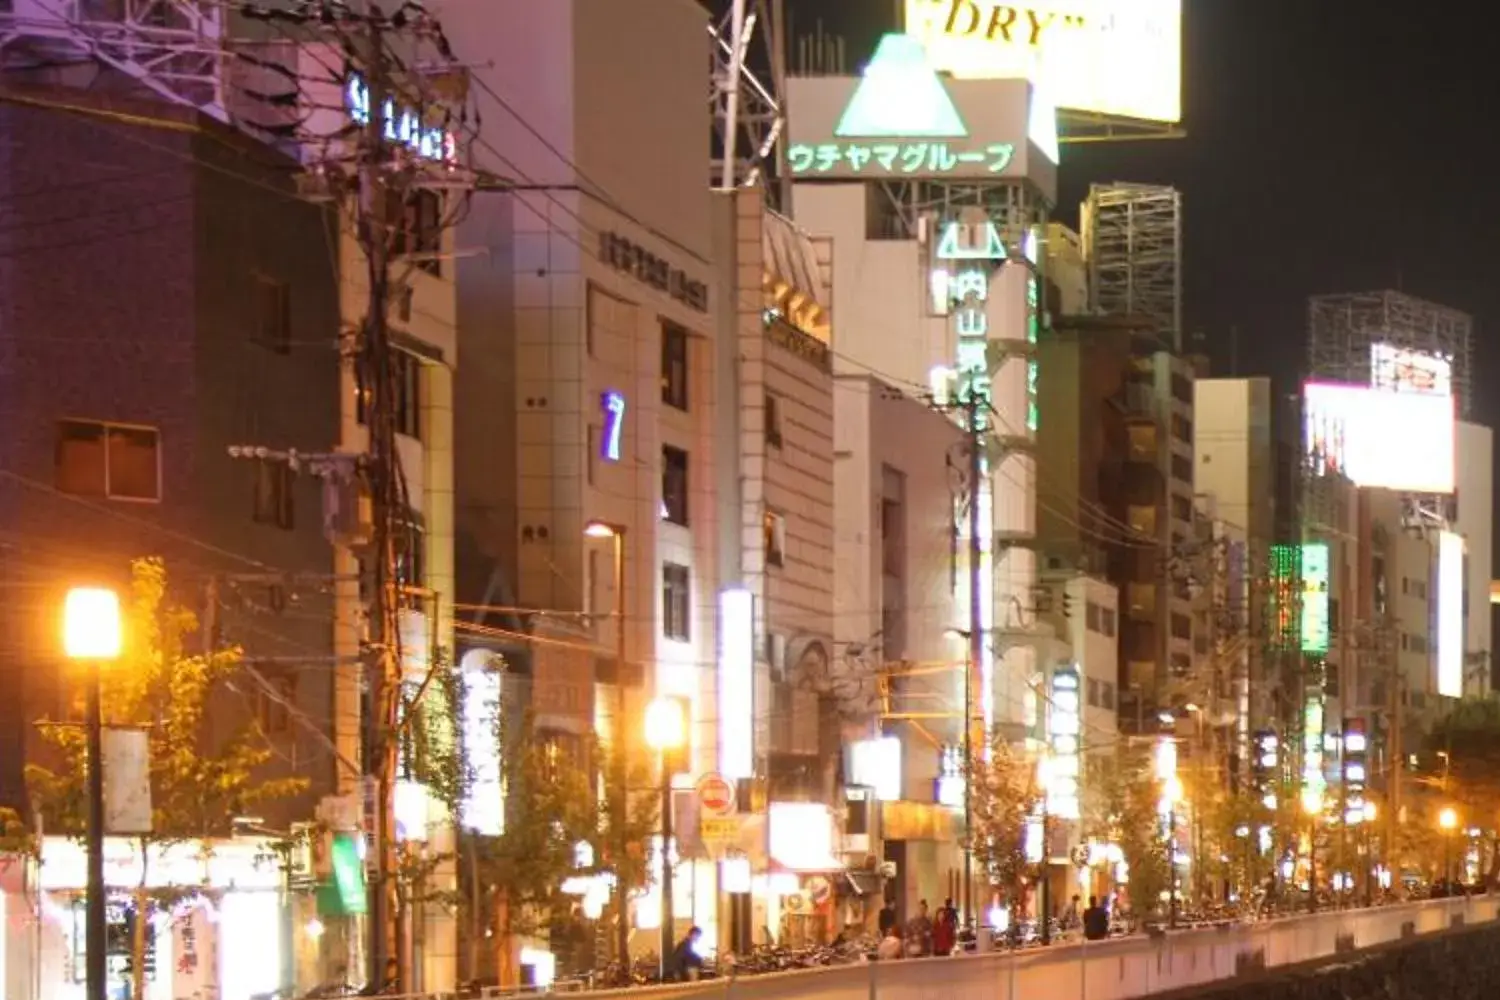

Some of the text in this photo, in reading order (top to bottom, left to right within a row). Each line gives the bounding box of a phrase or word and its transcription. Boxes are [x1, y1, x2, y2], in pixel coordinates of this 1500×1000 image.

[788, 143, 1013, 173] ウチヤマグループ
